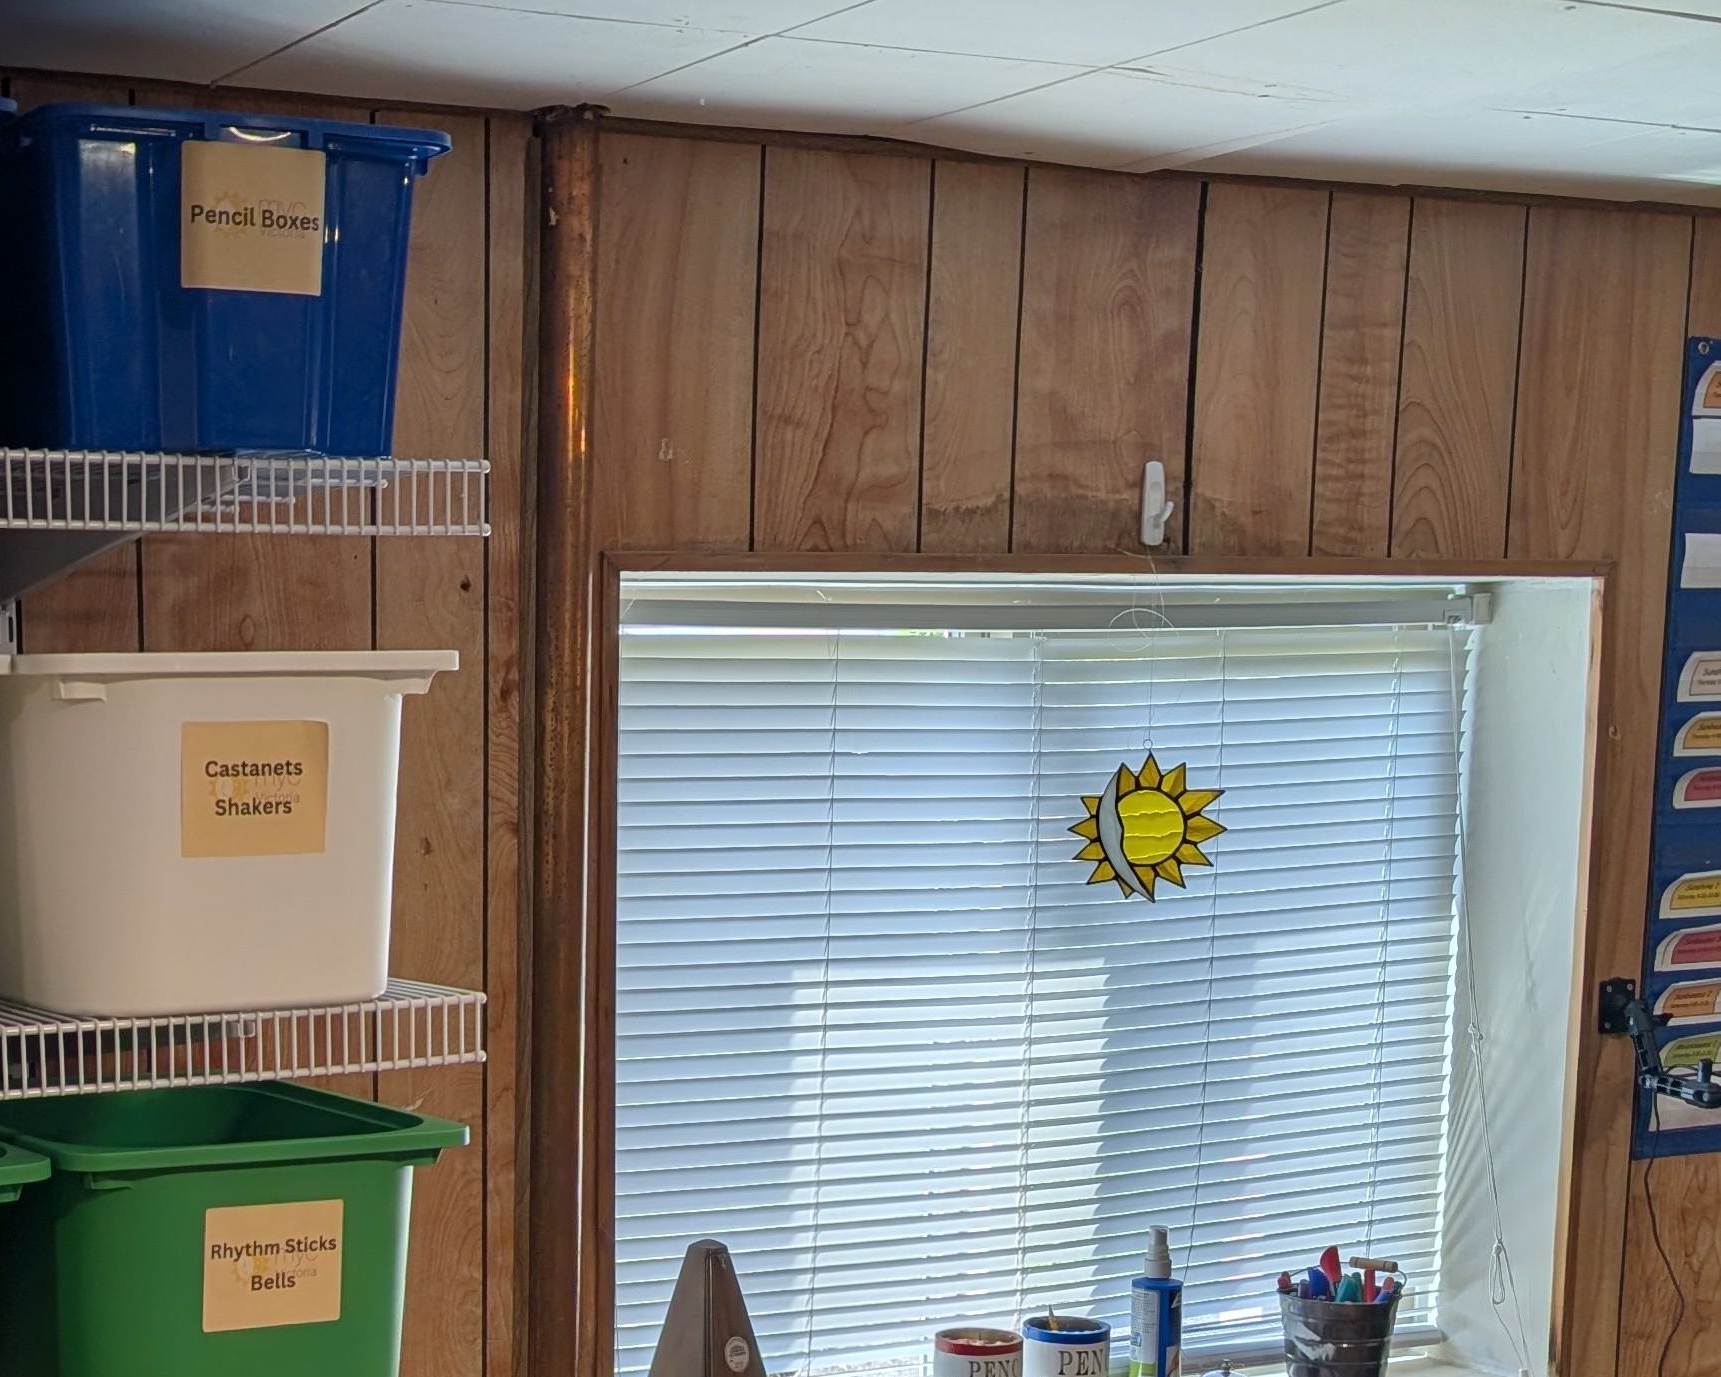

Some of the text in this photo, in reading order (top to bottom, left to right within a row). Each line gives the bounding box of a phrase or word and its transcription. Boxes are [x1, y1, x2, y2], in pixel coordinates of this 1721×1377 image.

[190, 204, 319, 231] Pencil Boxes
[205, 760, 303, 778] Castanets
[214, 798, 292, 816] Shakers
[211, 1235, 337, 1262] Rhythm Sticks
[251, 1272, 296, 1291] Bells
